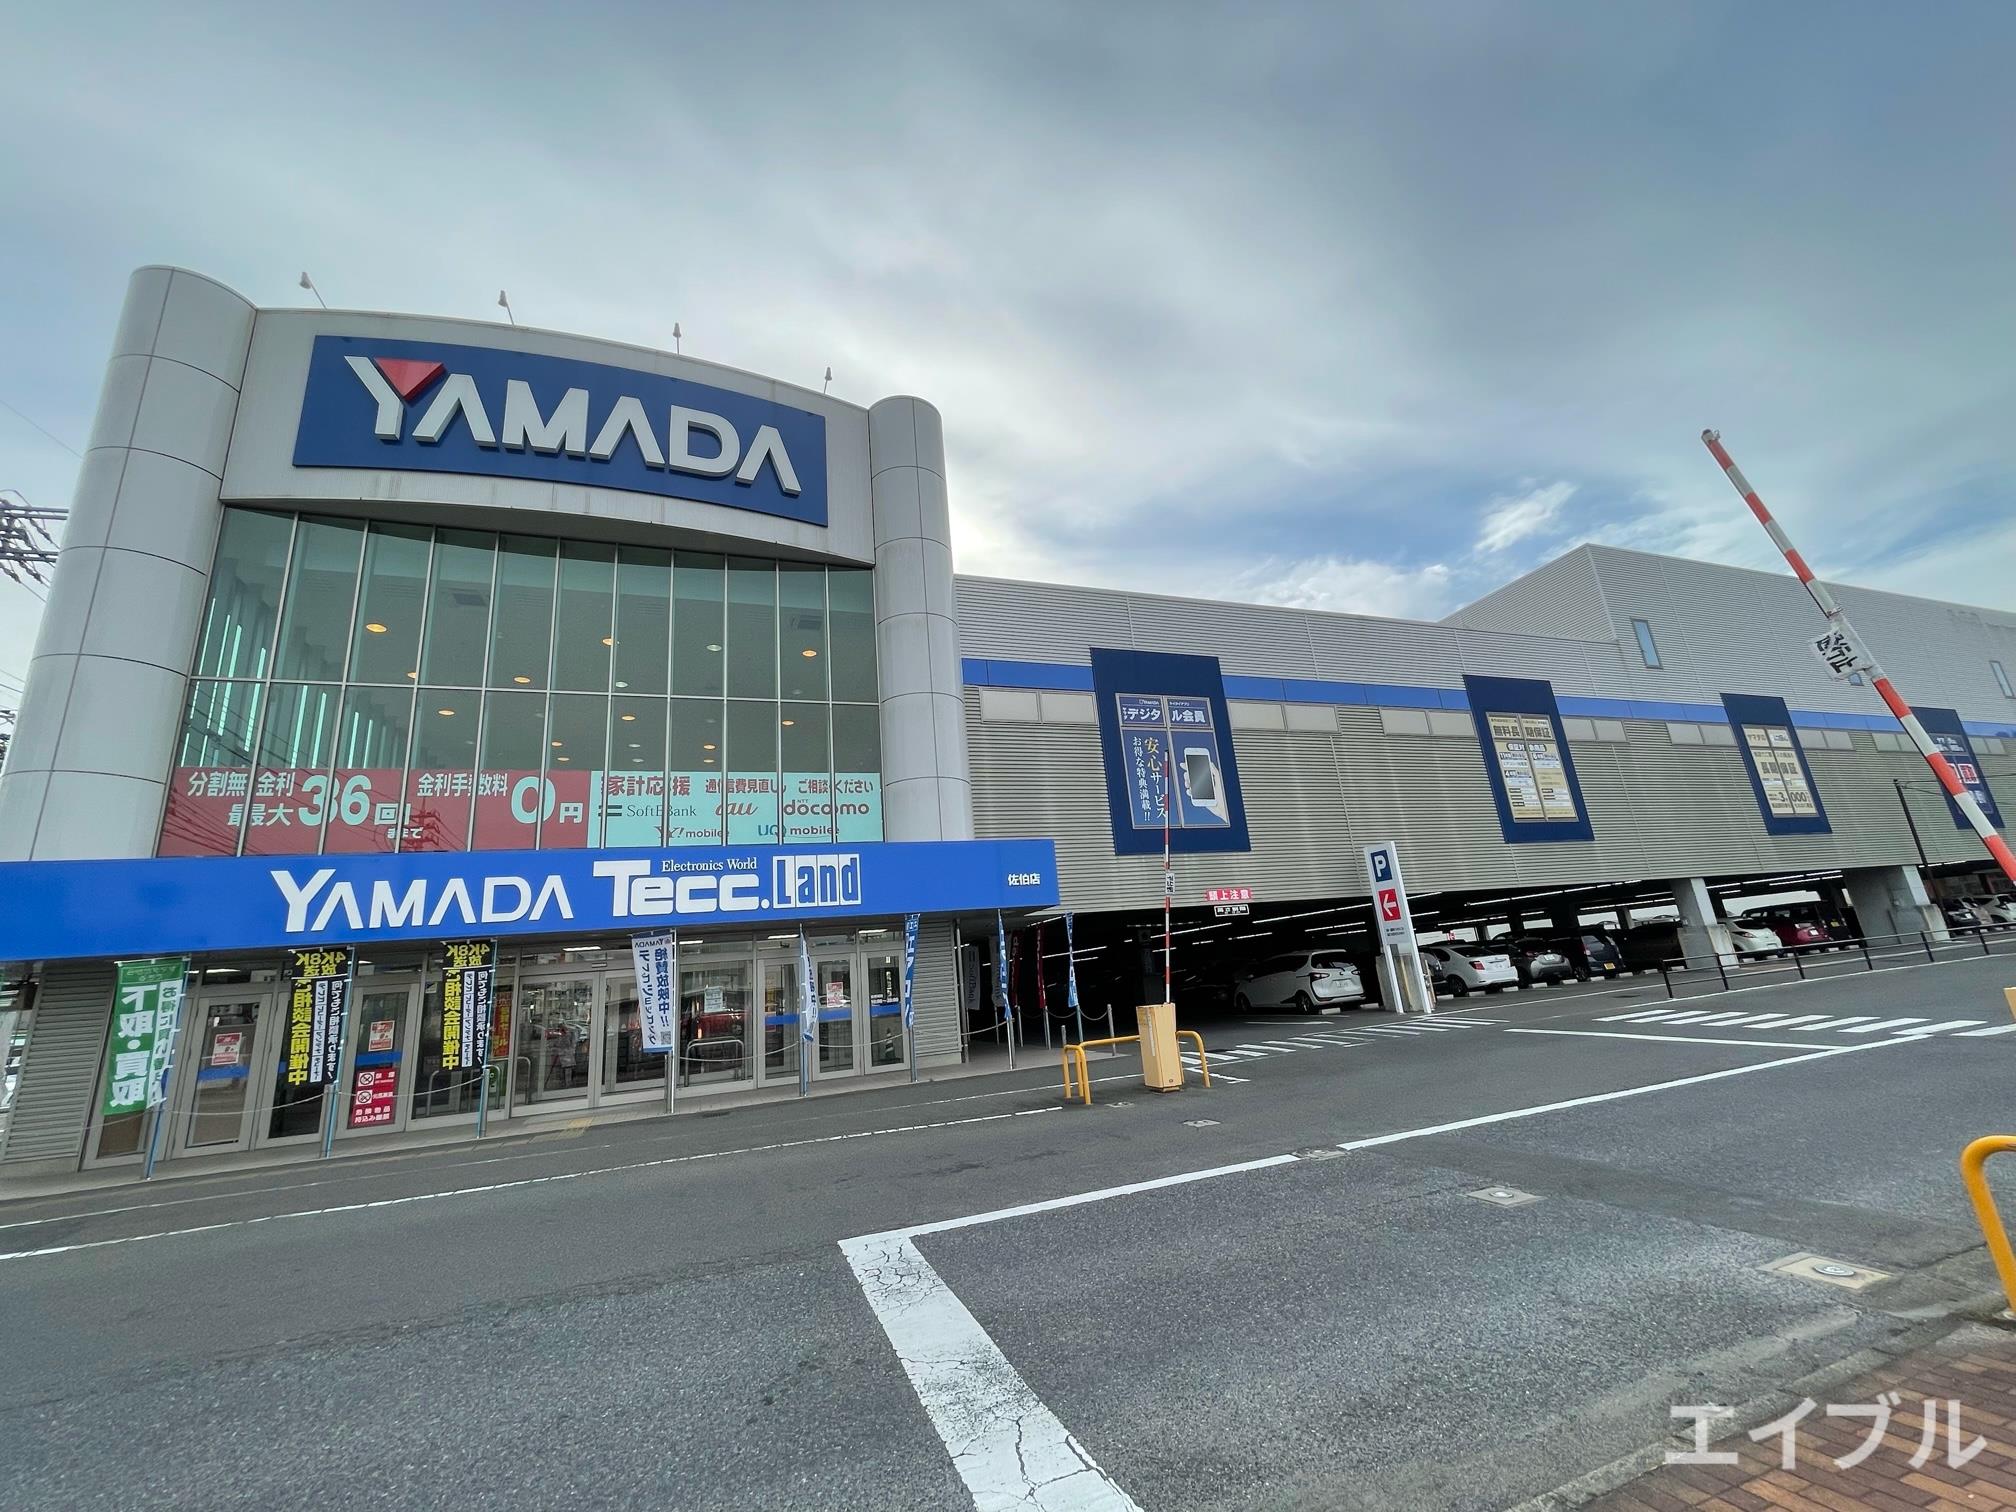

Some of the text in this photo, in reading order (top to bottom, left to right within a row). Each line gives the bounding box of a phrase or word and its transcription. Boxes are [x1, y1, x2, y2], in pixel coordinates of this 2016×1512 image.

[344, 355, 801, 497] YAMADA
[416, 772, 508, 798] 金利手数料
[601, 775, 691, 797] 家計応援
[1144, 738, 1167, 819] 安心サービス
[627, 804, 697, 818] SoftBank
[714, 800, 758, 817] au
[783, 799, 870, 816] docomo
[661, 856, 758, 872] Electronics World
[1374, 855, 1388, 877] P
[1007, 871, 1042, 887] 佐伯店
[269, 867, 576, 934] YAMADA
